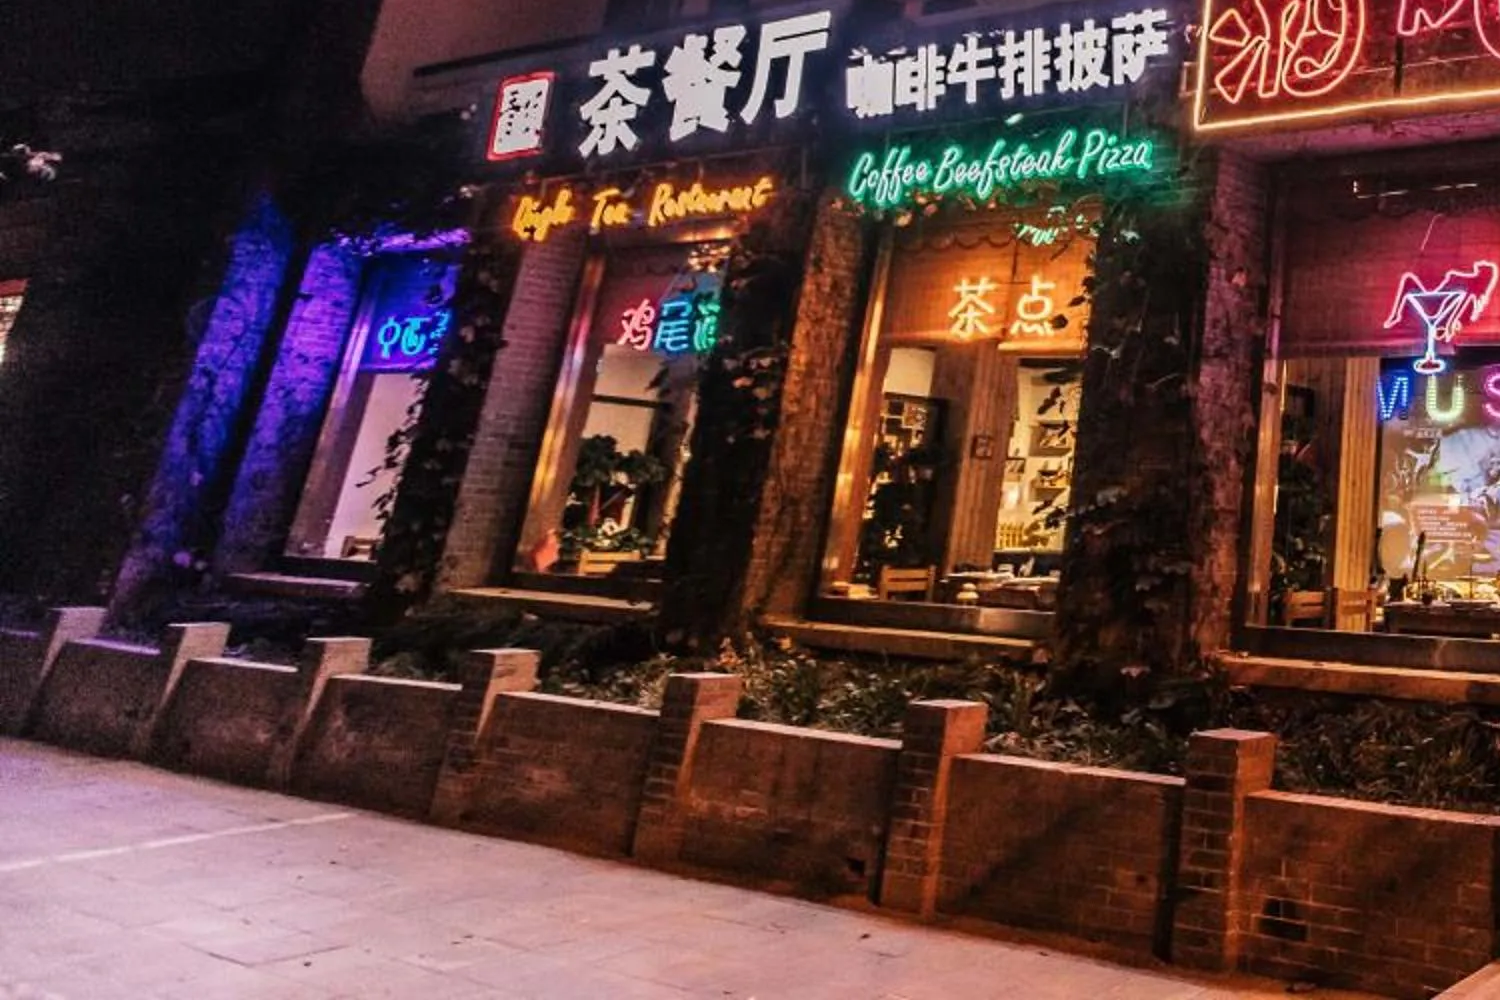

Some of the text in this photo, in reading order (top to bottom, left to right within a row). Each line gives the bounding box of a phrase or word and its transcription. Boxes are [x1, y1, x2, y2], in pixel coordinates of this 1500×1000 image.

[578, 11, 831, 159] 茶餐厅
[845, 8, 1169, 118] 咖啡牛排披萨
[850, 152, 932, 203] Coffee
[1076, 128, 1154, 180] Pizza
[947, 274, 1058, 338] 茶点
